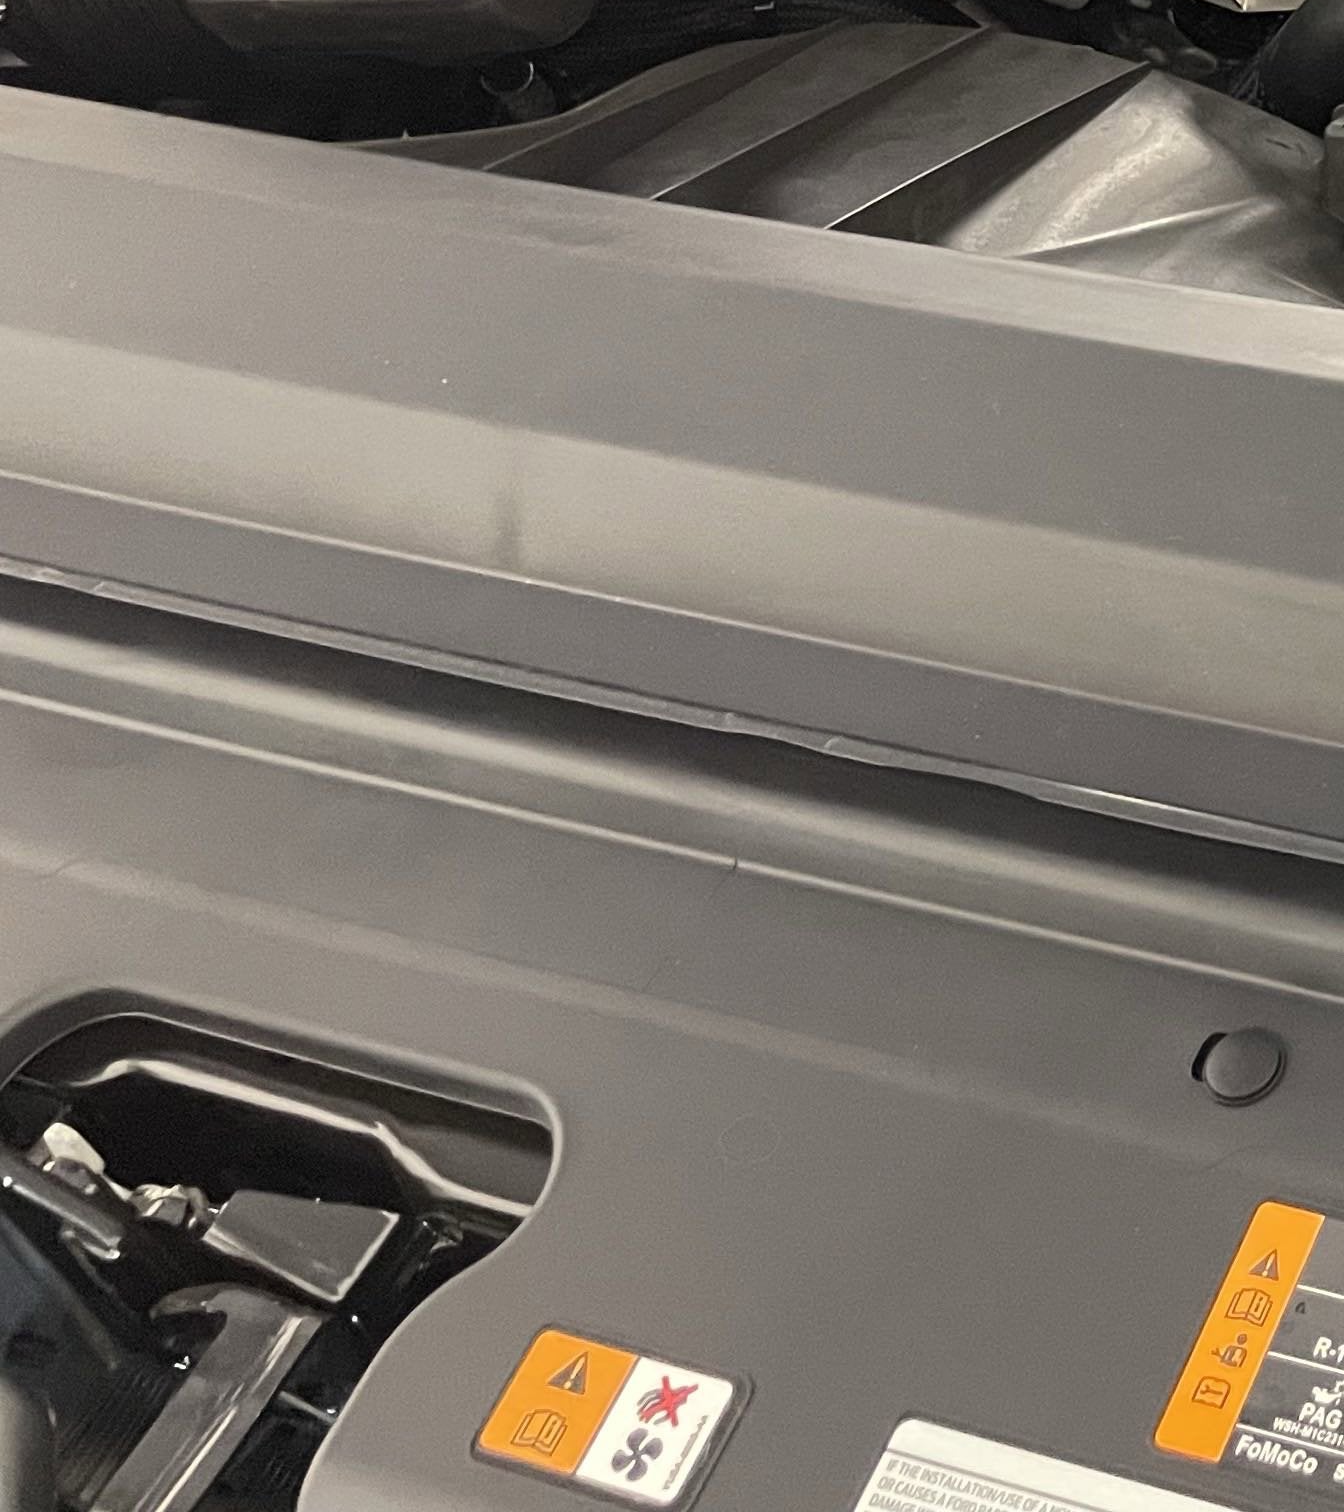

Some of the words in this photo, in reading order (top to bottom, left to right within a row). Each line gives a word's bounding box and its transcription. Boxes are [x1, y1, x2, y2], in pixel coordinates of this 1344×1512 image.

[1298, 1401, 1343, 1430] PAG
[1235, 1435, 1318, 1475] FoMoCo
[877, 1476, 895, 1492] OR
[894, 1481, 938, 1504] CAUSES
[937, 1493, 947, 1506] A
[898, 1462, 921, 1479] THE
[919, 1468, 1023, 1509] INSTALLATION/USE
